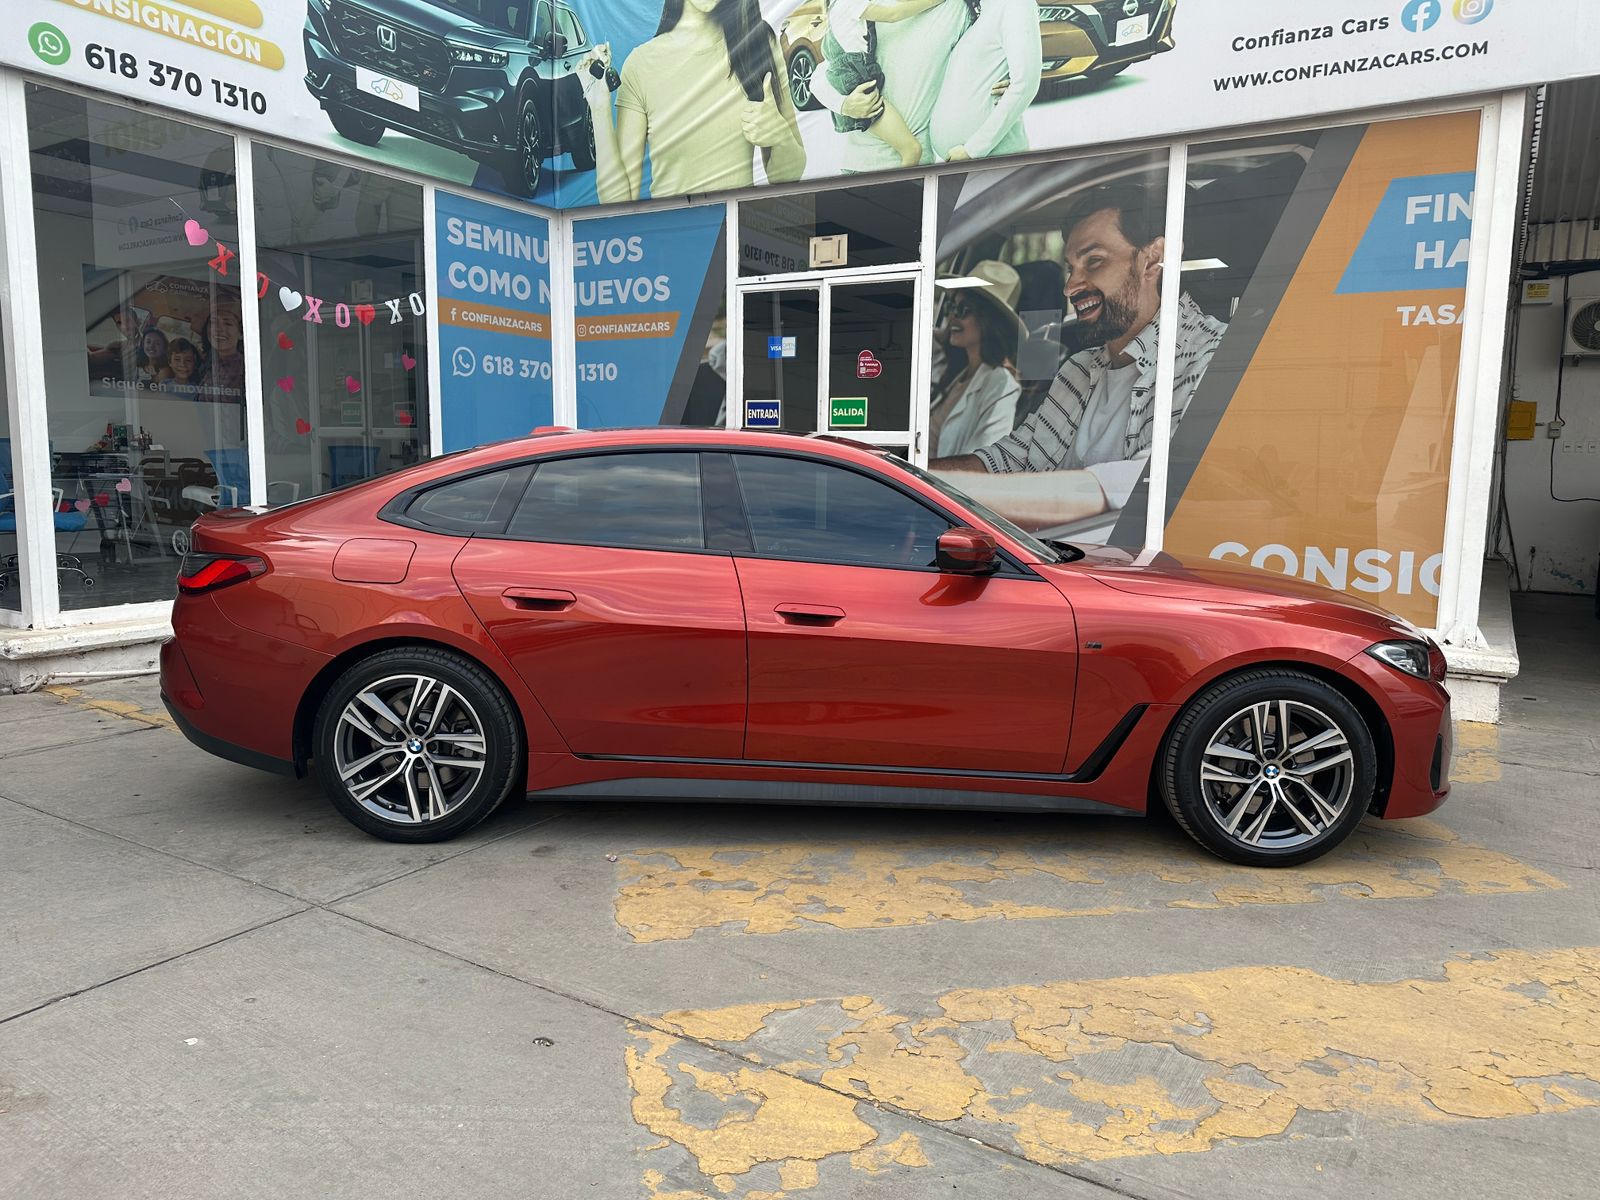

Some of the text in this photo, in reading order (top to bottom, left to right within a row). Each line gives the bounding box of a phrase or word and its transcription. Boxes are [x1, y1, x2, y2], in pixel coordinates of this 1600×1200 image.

[74, 0, 261, 62] NSIGNACIÓN
[1231, 16, 1389, 52] Confianza Cars
[84, 42, 267, 115] 618 370 1310
[1213, 41, 1489, 91] WWW.CONFIANZACARS.COM
[1405, 191, 1475, 225] FIN
[448, 261, 532, 300] COMO
[574, 275, 671, 307] UEVOS
[461, 310, 543, 333] CONFIANZACARS
[588, 321, 671, 335] CONFIANZACARS
[482, 355, 618, 382] 618 370 1310
[102, 377, 145, 391] Sigue
[149, 382, 167, 393] en
[748, 408, 779, 419] ENTRADA
[832, 407, 864, 417] SALIDA
